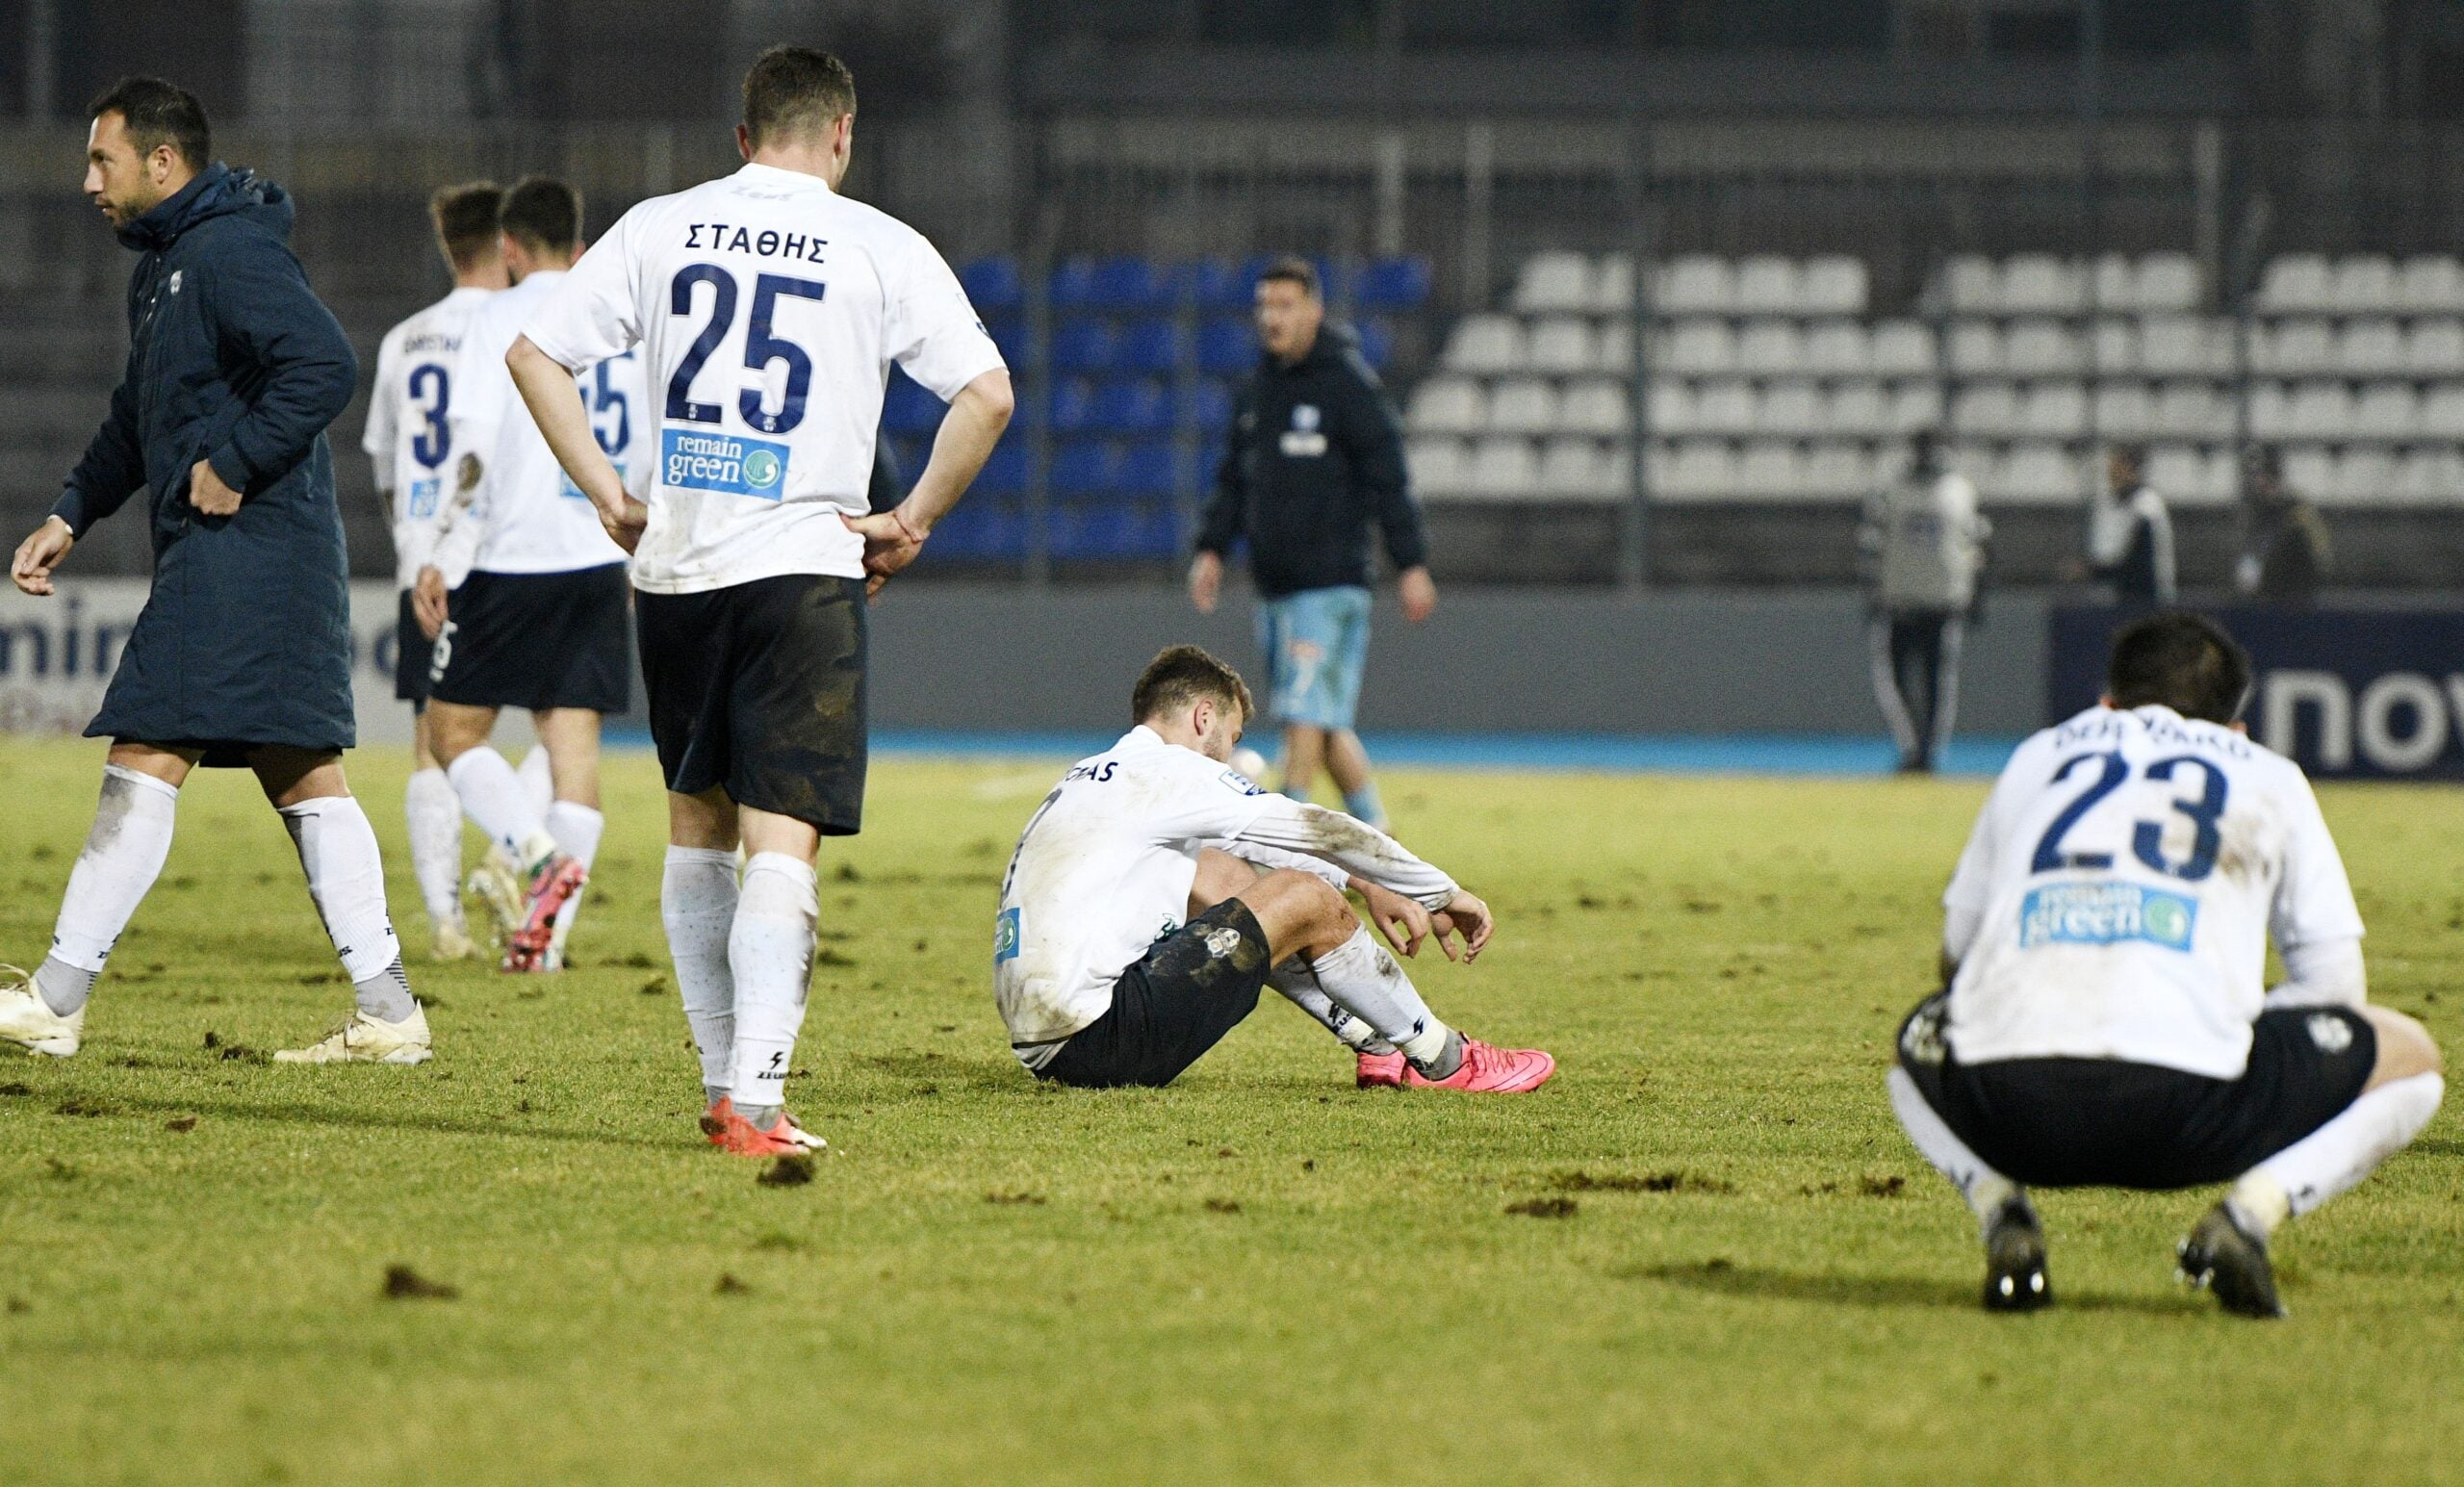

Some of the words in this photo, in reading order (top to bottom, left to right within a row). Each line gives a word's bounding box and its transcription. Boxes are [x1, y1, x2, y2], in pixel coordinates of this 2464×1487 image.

[685, 223, 828, 264] ΣΤΑΘΗΣ
[664, 262, 829, 435] 25
[409, 362, 451, 470] 3
[579, 349, 634, 456] 5
[677, 435, 742, 459] remain
[668, 453, 741, 485] green
[2265, 669, 2464, 771] no
[2031, 751, 2229, 883] 23
[2025, 902, 2143, 946] green
